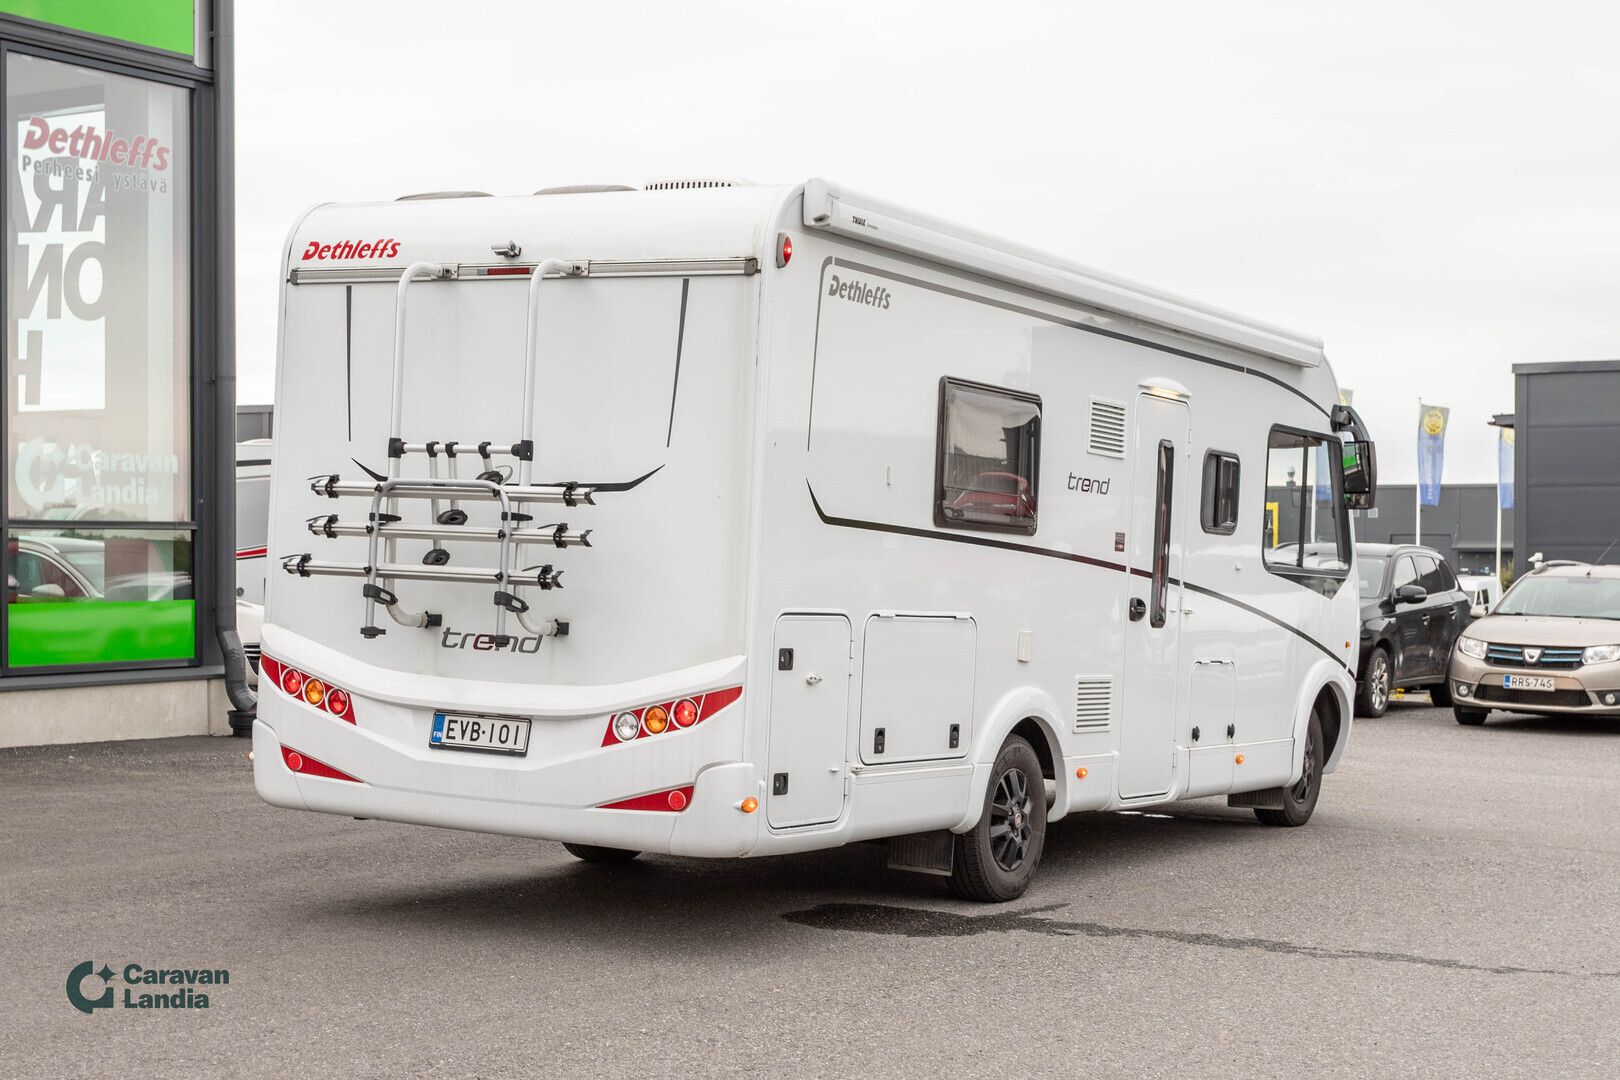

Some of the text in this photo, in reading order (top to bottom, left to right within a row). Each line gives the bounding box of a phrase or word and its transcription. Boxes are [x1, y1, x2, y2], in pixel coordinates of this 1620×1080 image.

[23, 116, 169, 171] Dethleffs
[22, 155, 168, 193] Perheesi ystävä
[302, 238, 401, 261] Dethleffs
[828, 274, 891, 310] Dethleffs
[74, 443, 178, 474] Caravan
[76, 477, 160, 505] Landia
[1067, 472, 1110, 495] trend
